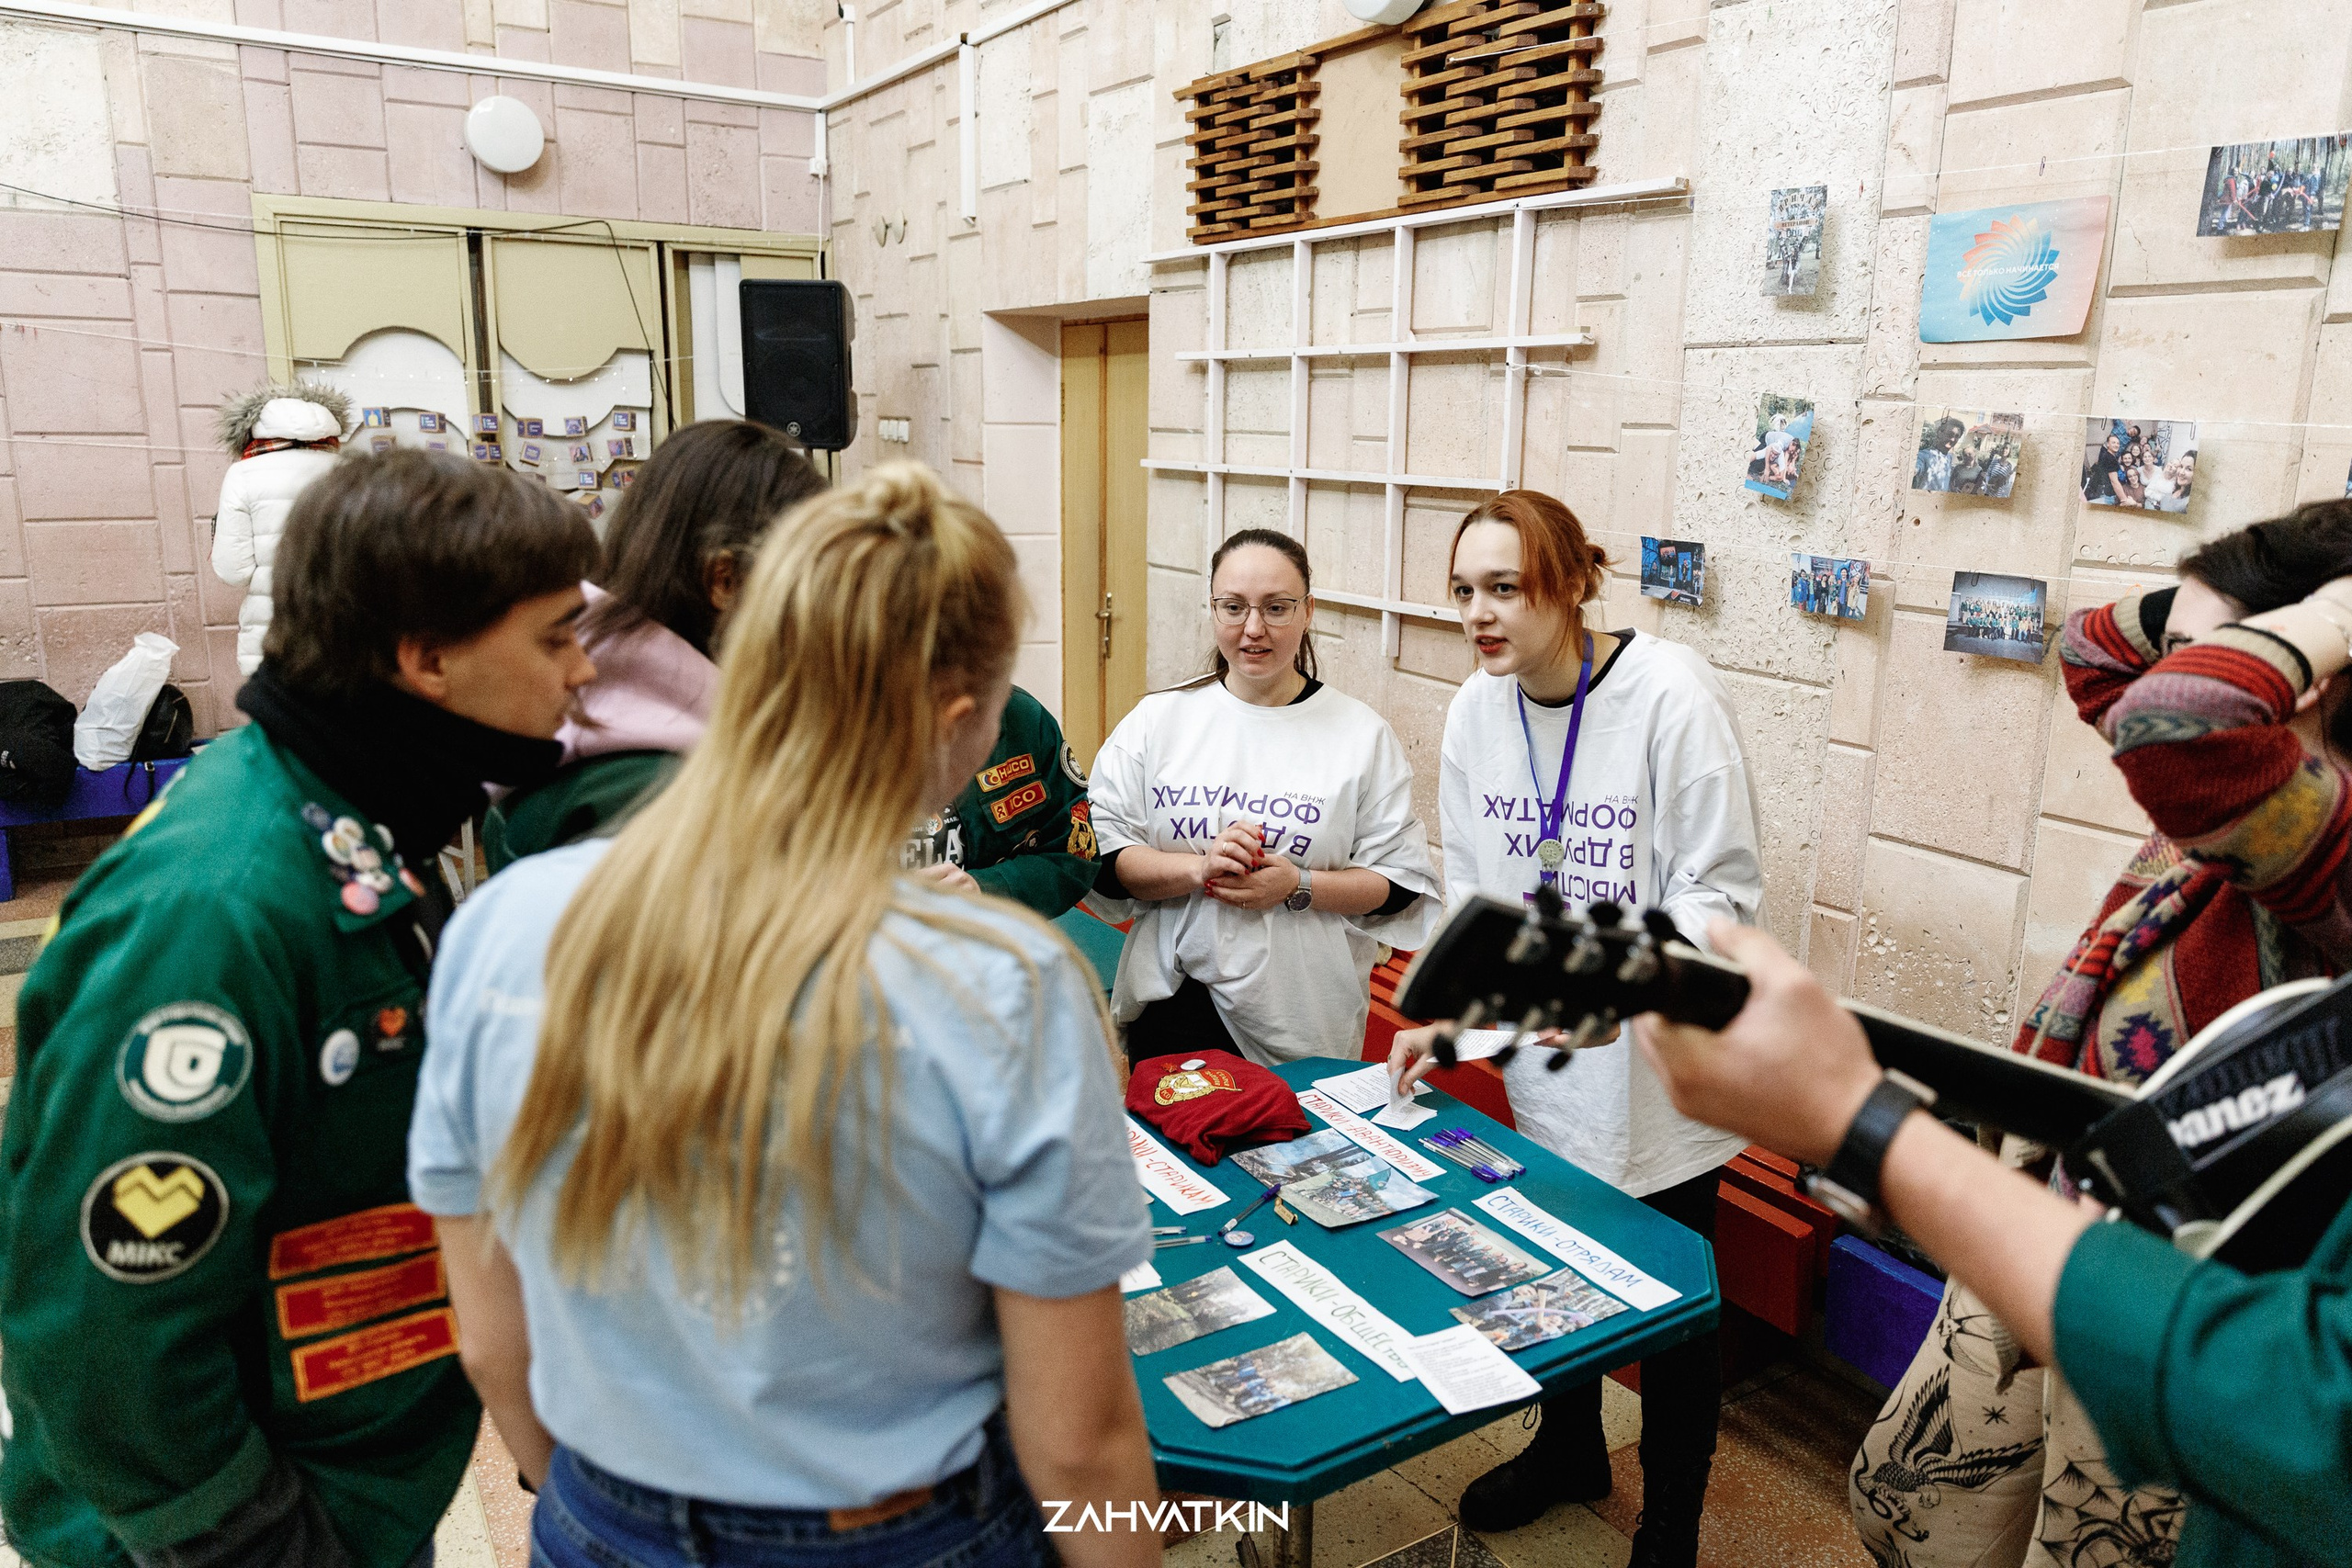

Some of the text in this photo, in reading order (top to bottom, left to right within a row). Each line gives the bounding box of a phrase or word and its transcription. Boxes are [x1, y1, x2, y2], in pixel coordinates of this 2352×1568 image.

[1973, 266, 2005, 276] ТОЛЬКО
[2006, 263, 2059, 275] НАЧИНАЕТСЯ
[1151, 785, 1321, 825] ФОРМАТАХ
[1283, 791, 1327, 806] НА ВНЖ
[1604, 795, 1619, 804] НА
[1170, 817, 1313, 858] В ДИХ
[1504, 832, 1613, 868] ДРУИХ
[1620, 843, 1634, 870] В
